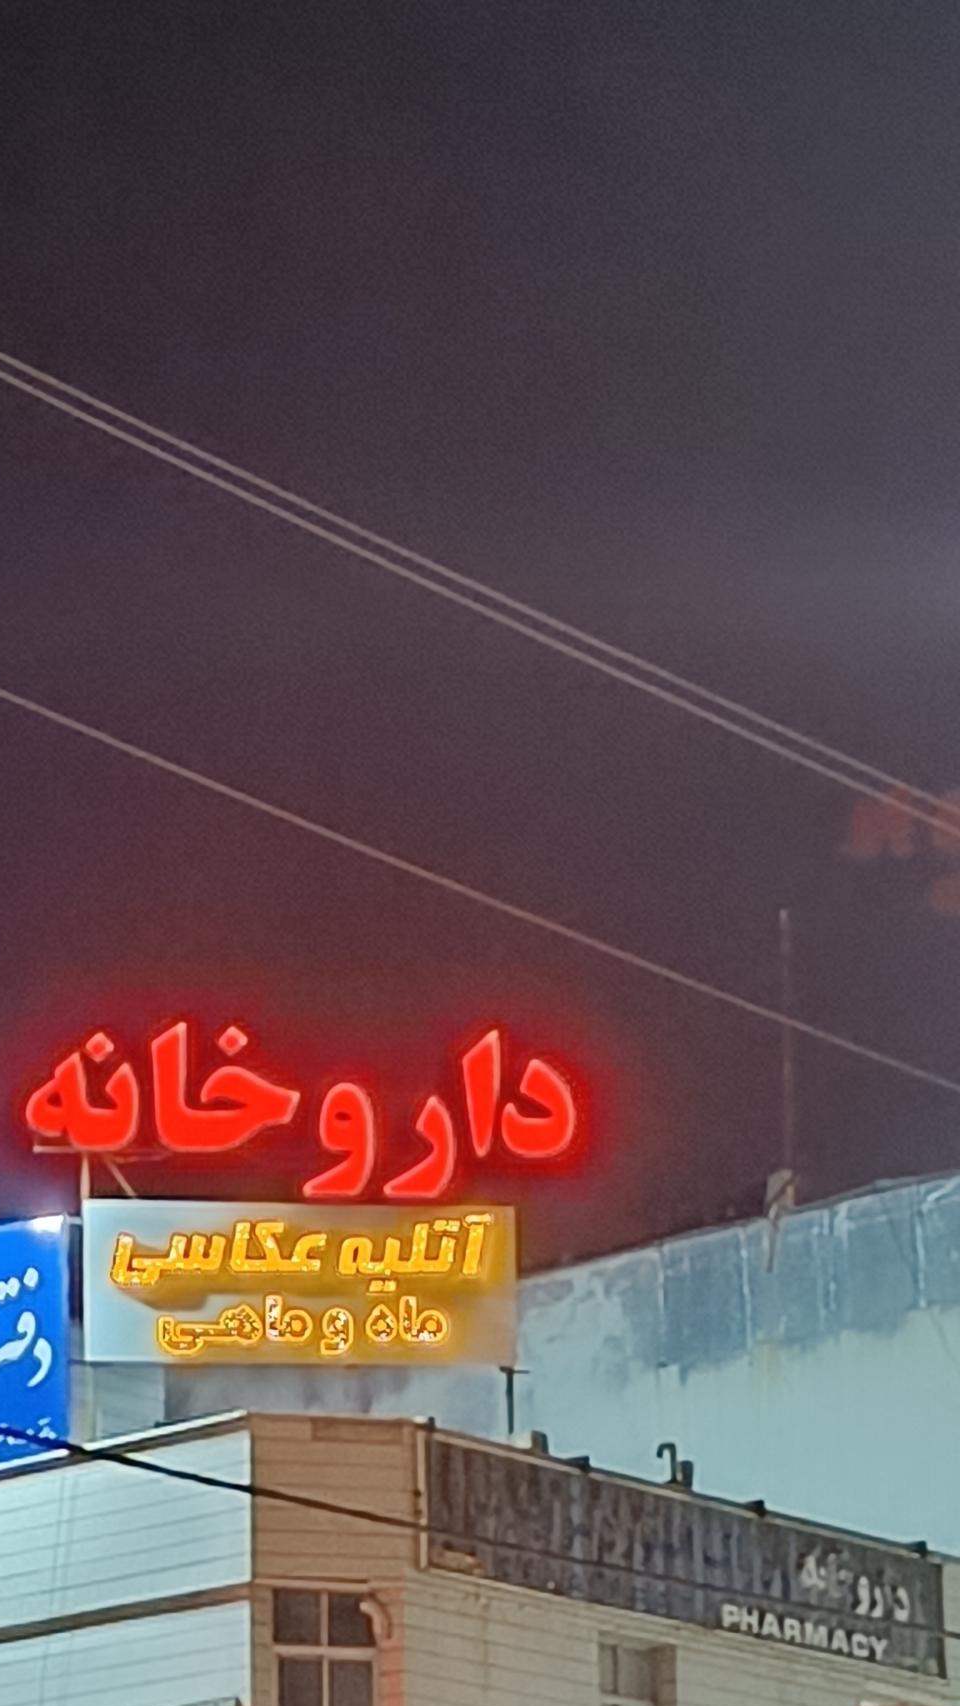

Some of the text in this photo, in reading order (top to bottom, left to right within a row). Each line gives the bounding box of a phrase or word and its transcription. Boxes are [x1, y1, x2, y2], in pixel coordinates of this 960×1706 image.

[24, 1020, 579, 1199] داروخانه
[108, 1213, 494, 1295] آتلیه عکاسی
[156, 1295, 450, 1356] ماه و ماهی
[719, 1602, 889, 1662] PHARMACY
